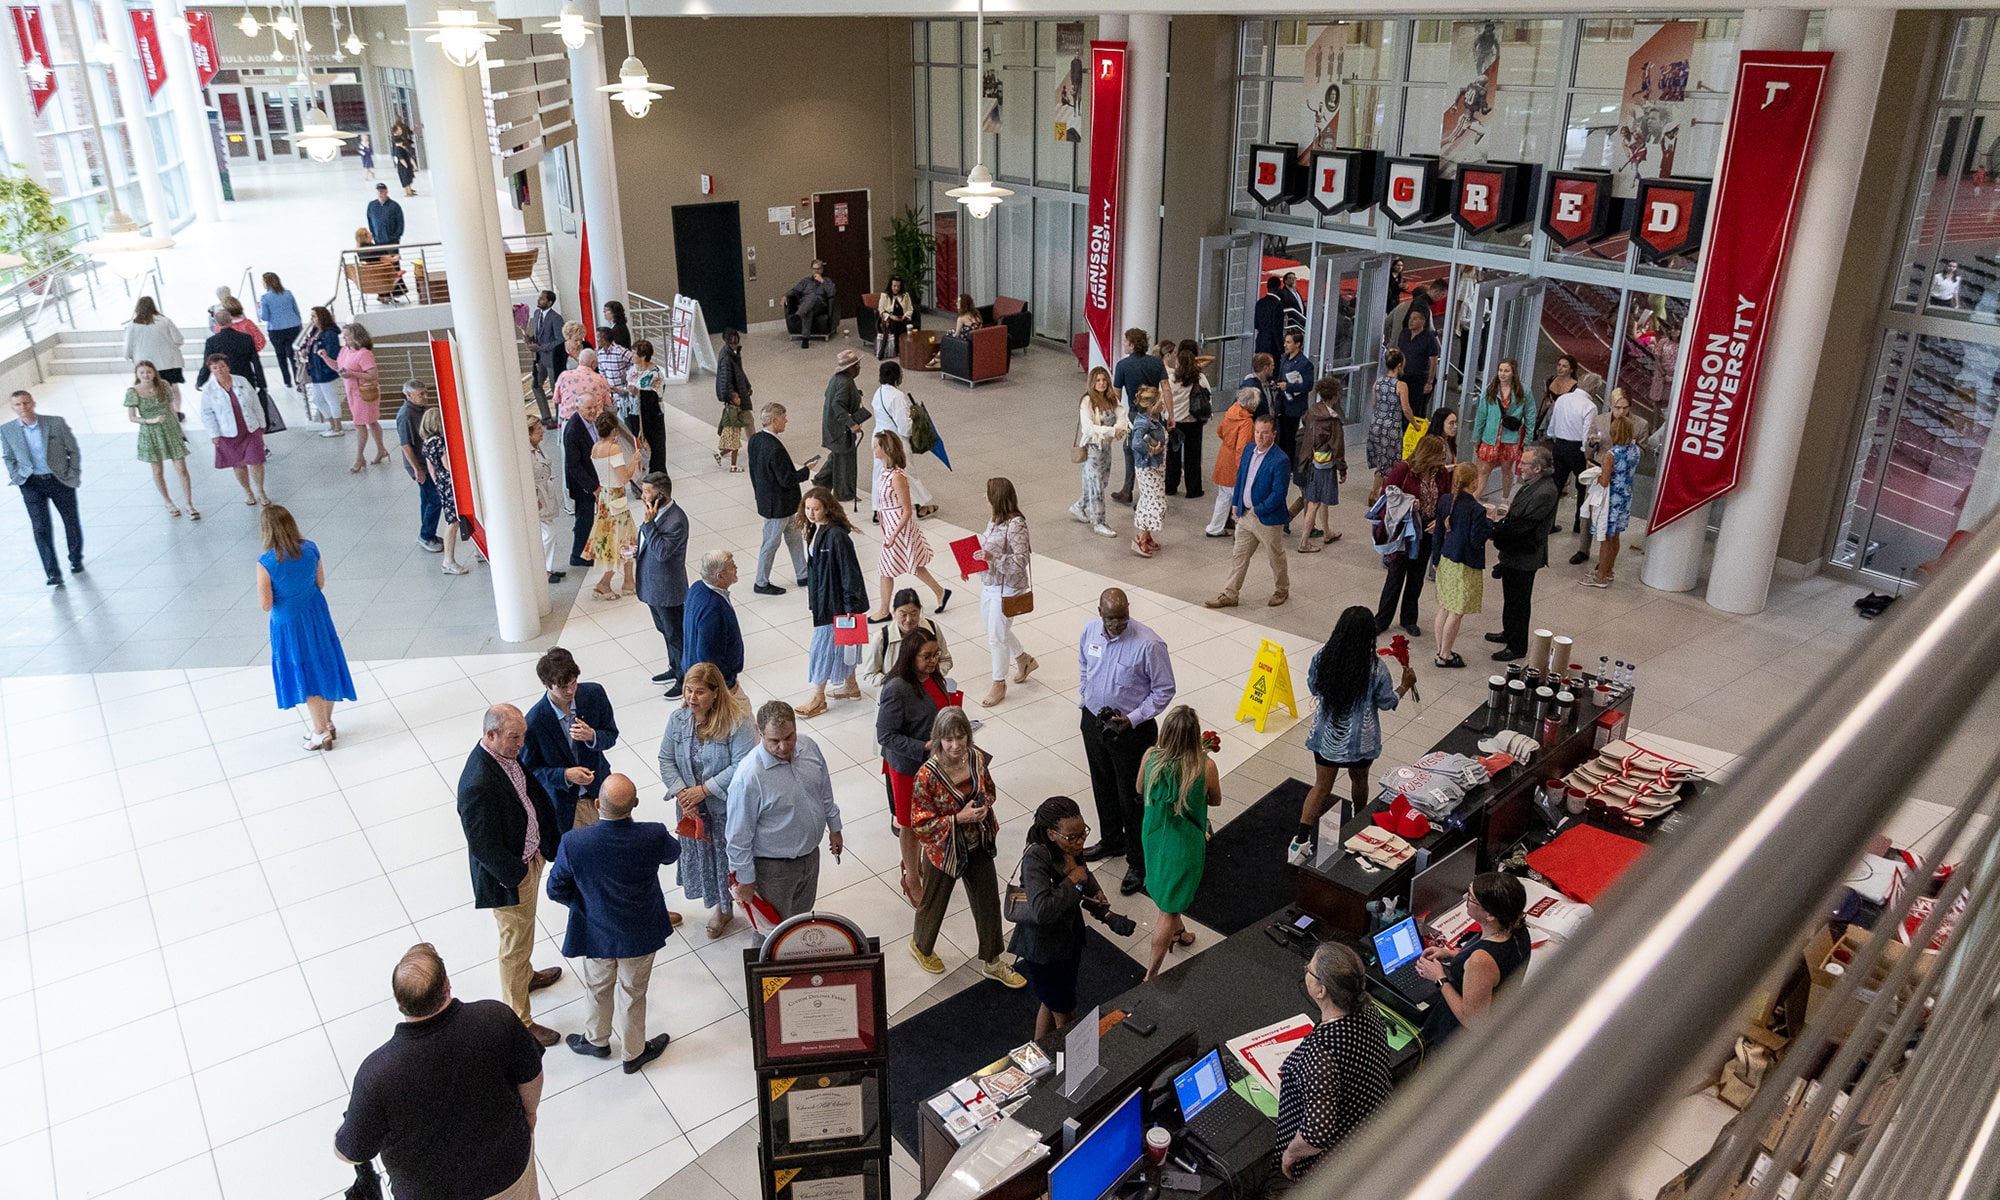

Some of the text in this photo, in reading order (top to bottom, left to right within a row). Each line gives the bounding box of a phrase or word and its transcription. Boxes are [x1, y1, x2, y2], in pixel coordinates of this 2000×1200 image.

[1258, 162, 1679, 233] BIG RED
[1096, 198, 1111, 310] UNIVERSITY
[1681, 333, 1730, 456] DENISON
[1703, 293, 1756, 460] UNIVERSITY
[1249, 694, 1264, 705] FLOOR
[1254, 690, 1263, 698] WET
[783, 946, 846, 957] DENISON UNIVERSITY
